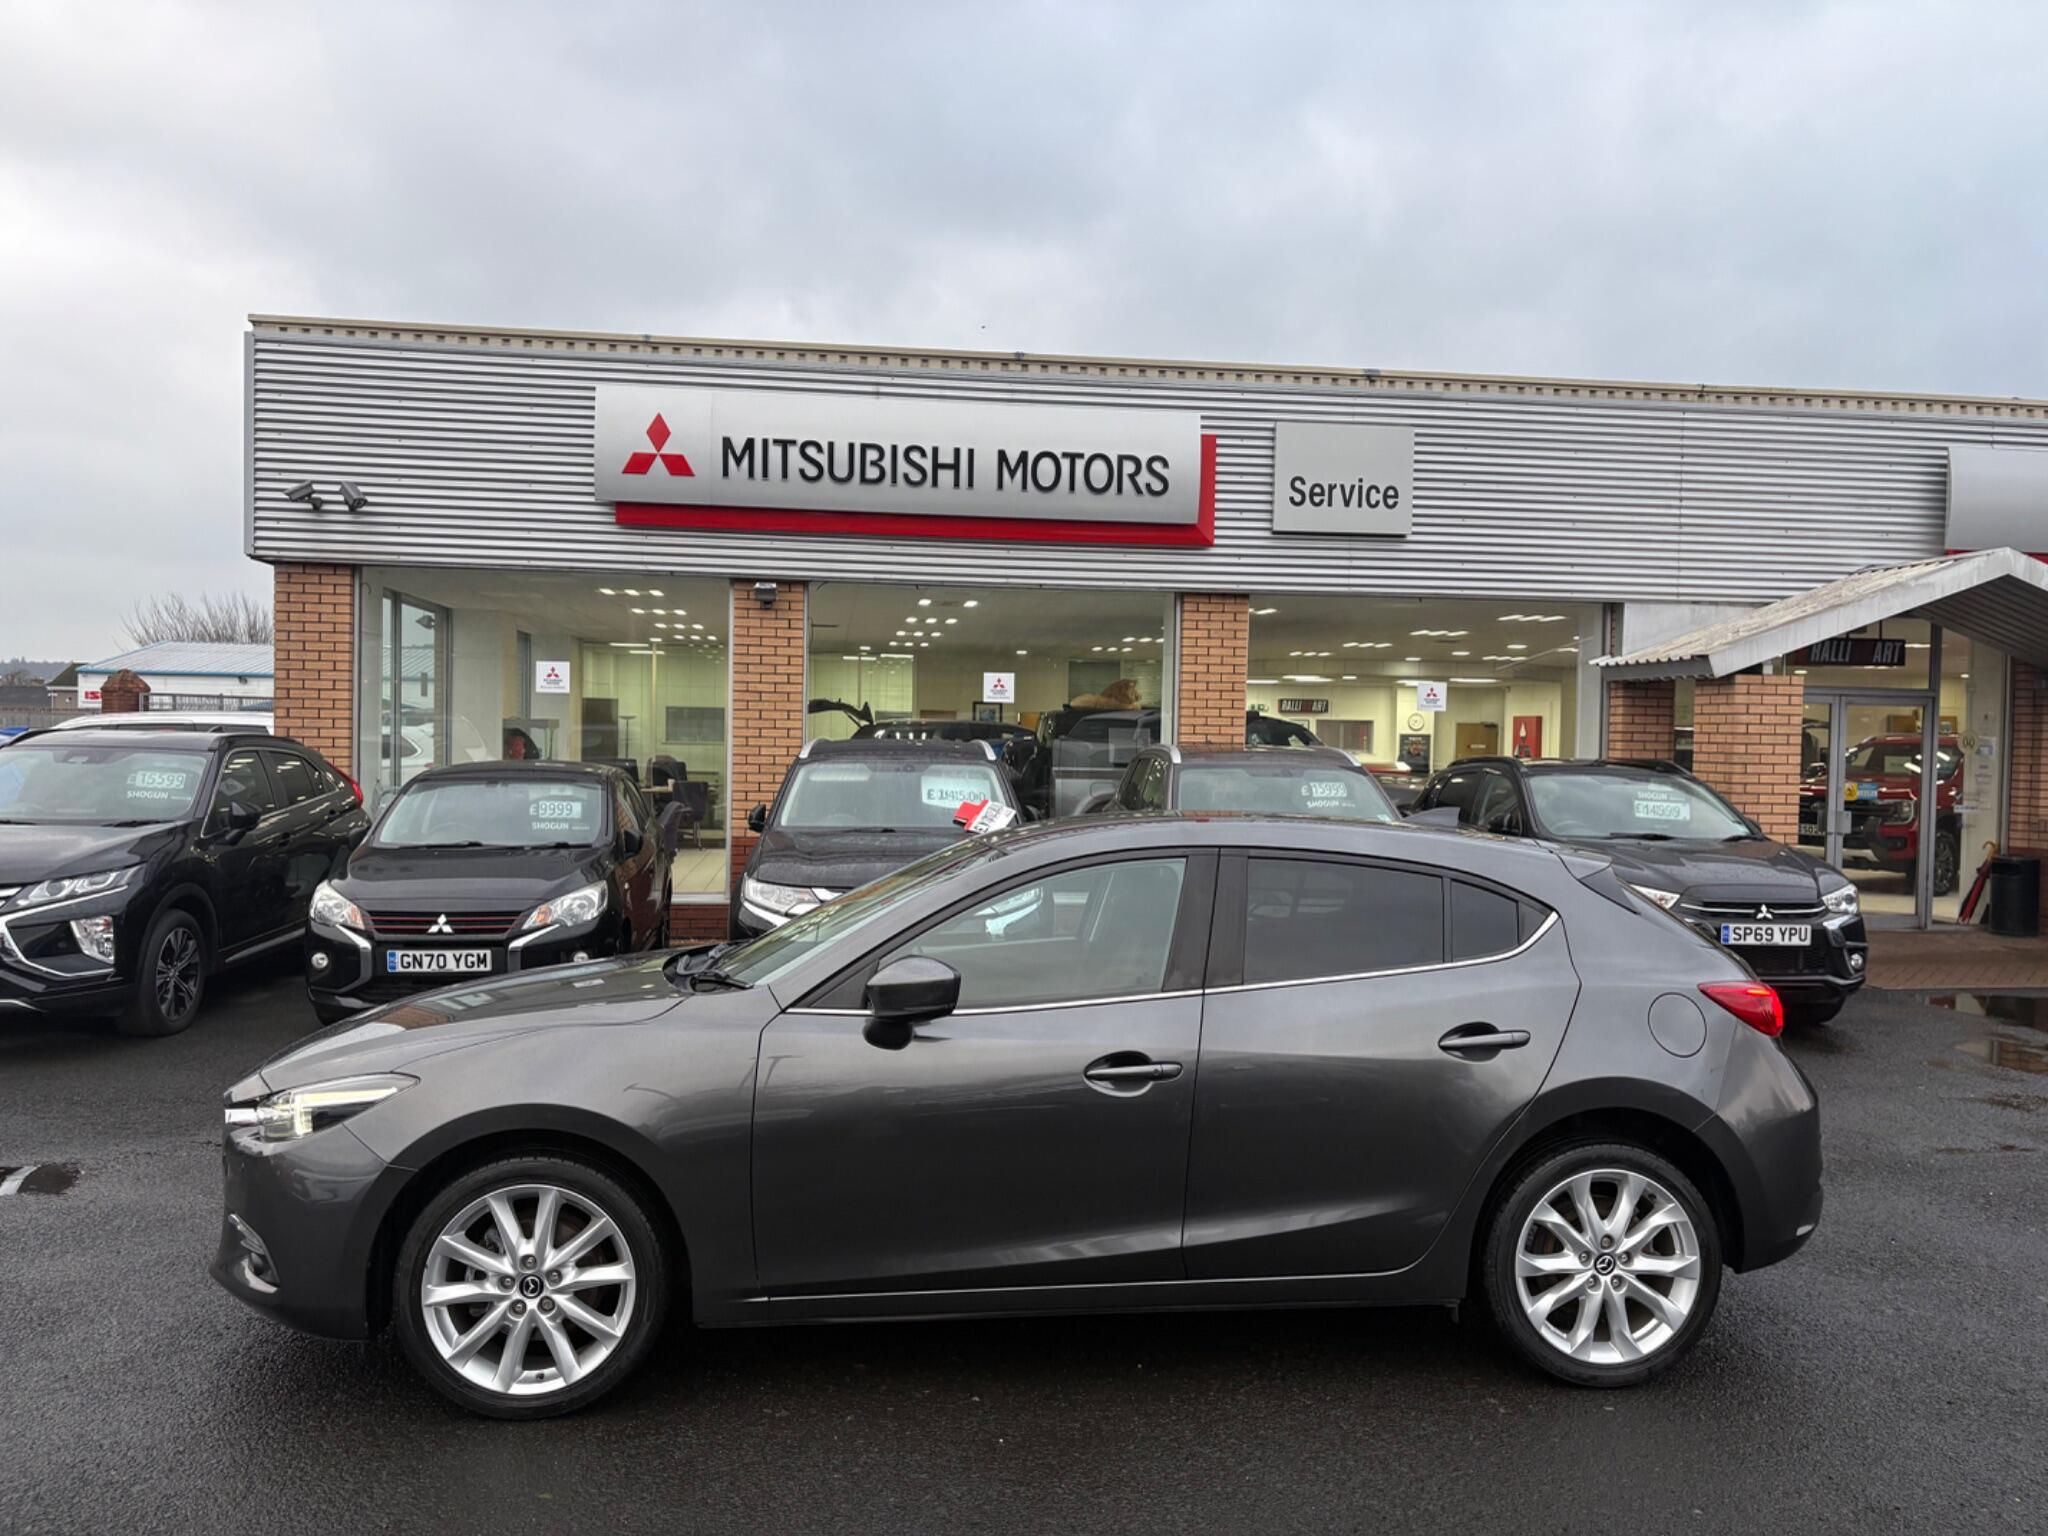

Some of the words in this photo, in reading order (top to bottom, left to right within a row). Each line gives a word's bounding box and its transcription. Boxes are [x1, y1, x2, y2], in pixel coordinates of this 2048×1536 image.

[722, 436, 975, 489] MITSUBISHI
[997, 448, 1170, 497] MOTORS
[1289, 476, 1400, 509] Service
[127, 791, 168, 799] SHOGUN
[531, 822, 569, 830] SHOGUN
[1733, 926, 1774, 942] SP69
[1779, 926, 1808, 942] YPU
[400, 953, 447, 969] GN70
[453, 953, 487, 969] YGM
